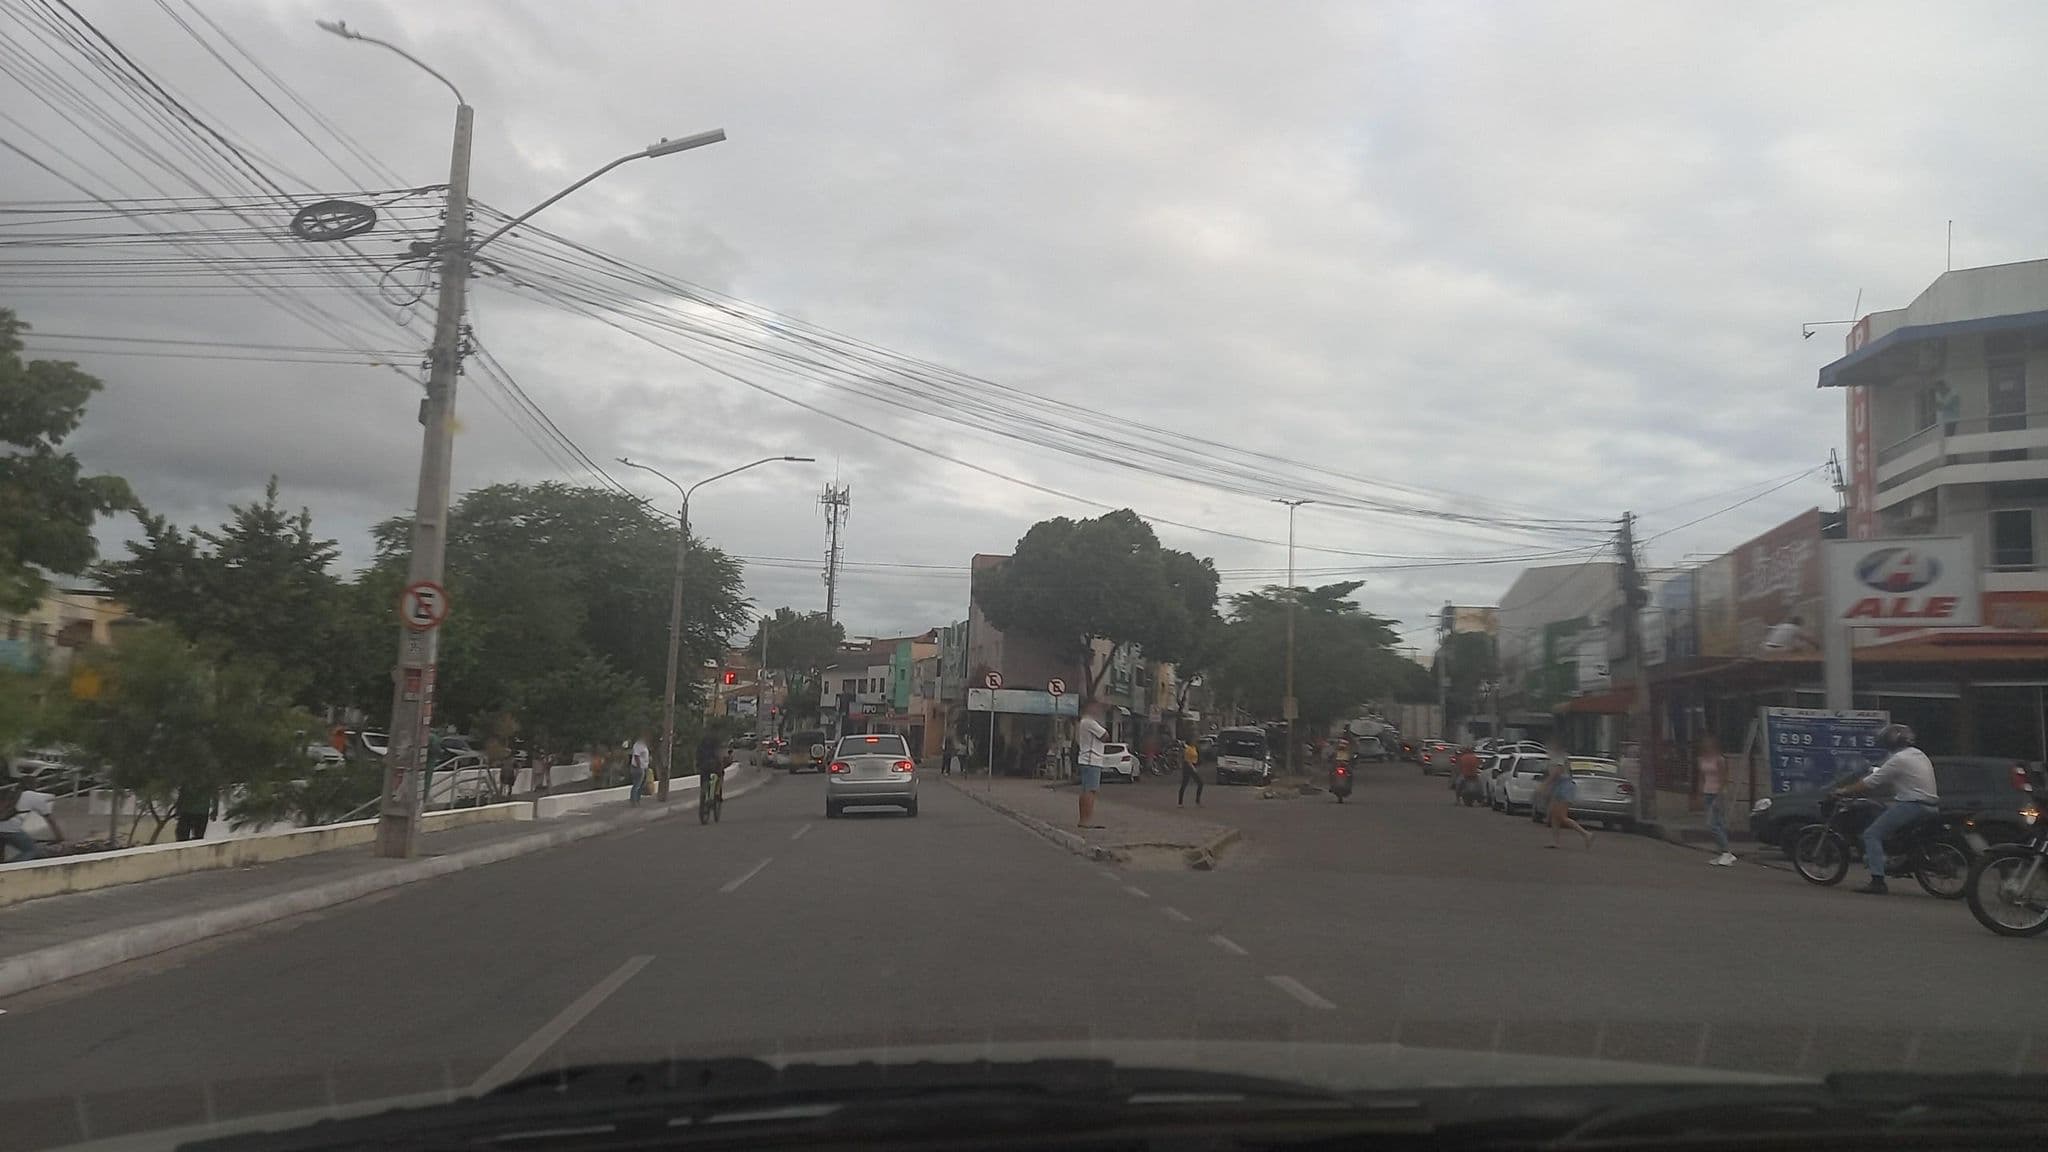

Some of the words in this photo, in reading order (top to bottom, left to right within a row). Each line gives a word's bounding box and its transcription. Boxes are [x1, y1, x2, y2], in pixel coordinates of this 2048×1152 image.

[1842, 597, 1959, 618] ALE
[1780, 733, 1813, 745] 699
[1833, 736, 1875, 747] 715
